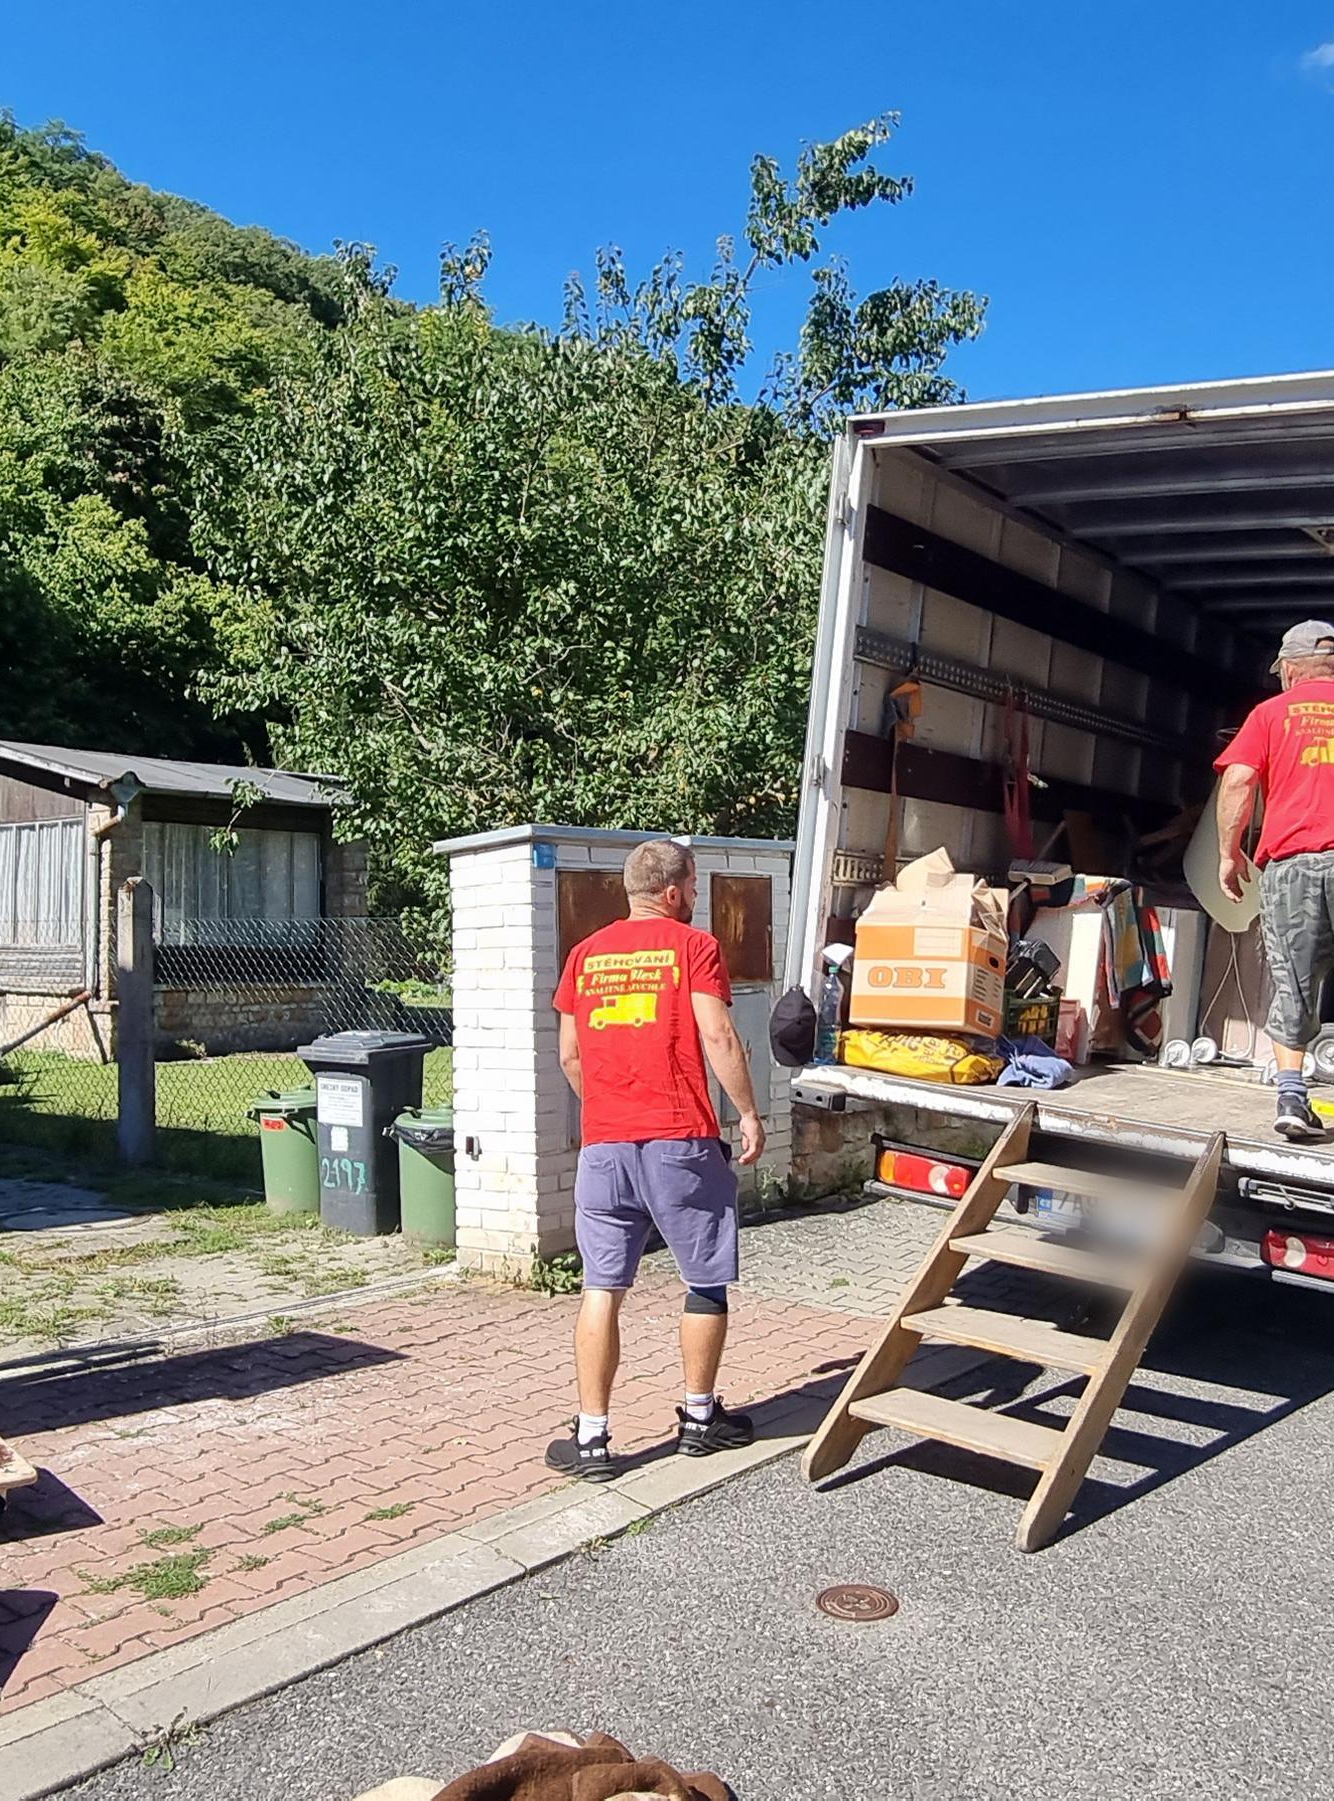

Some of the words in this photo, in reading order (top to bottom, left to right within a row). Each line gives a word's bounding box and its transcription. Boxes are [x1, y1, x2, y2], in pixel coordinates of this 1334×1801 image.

[590, 972, 628, 986] Firma
[630, 968, 662, 982] Blesk
[868, 966, 947, 989] OBI
